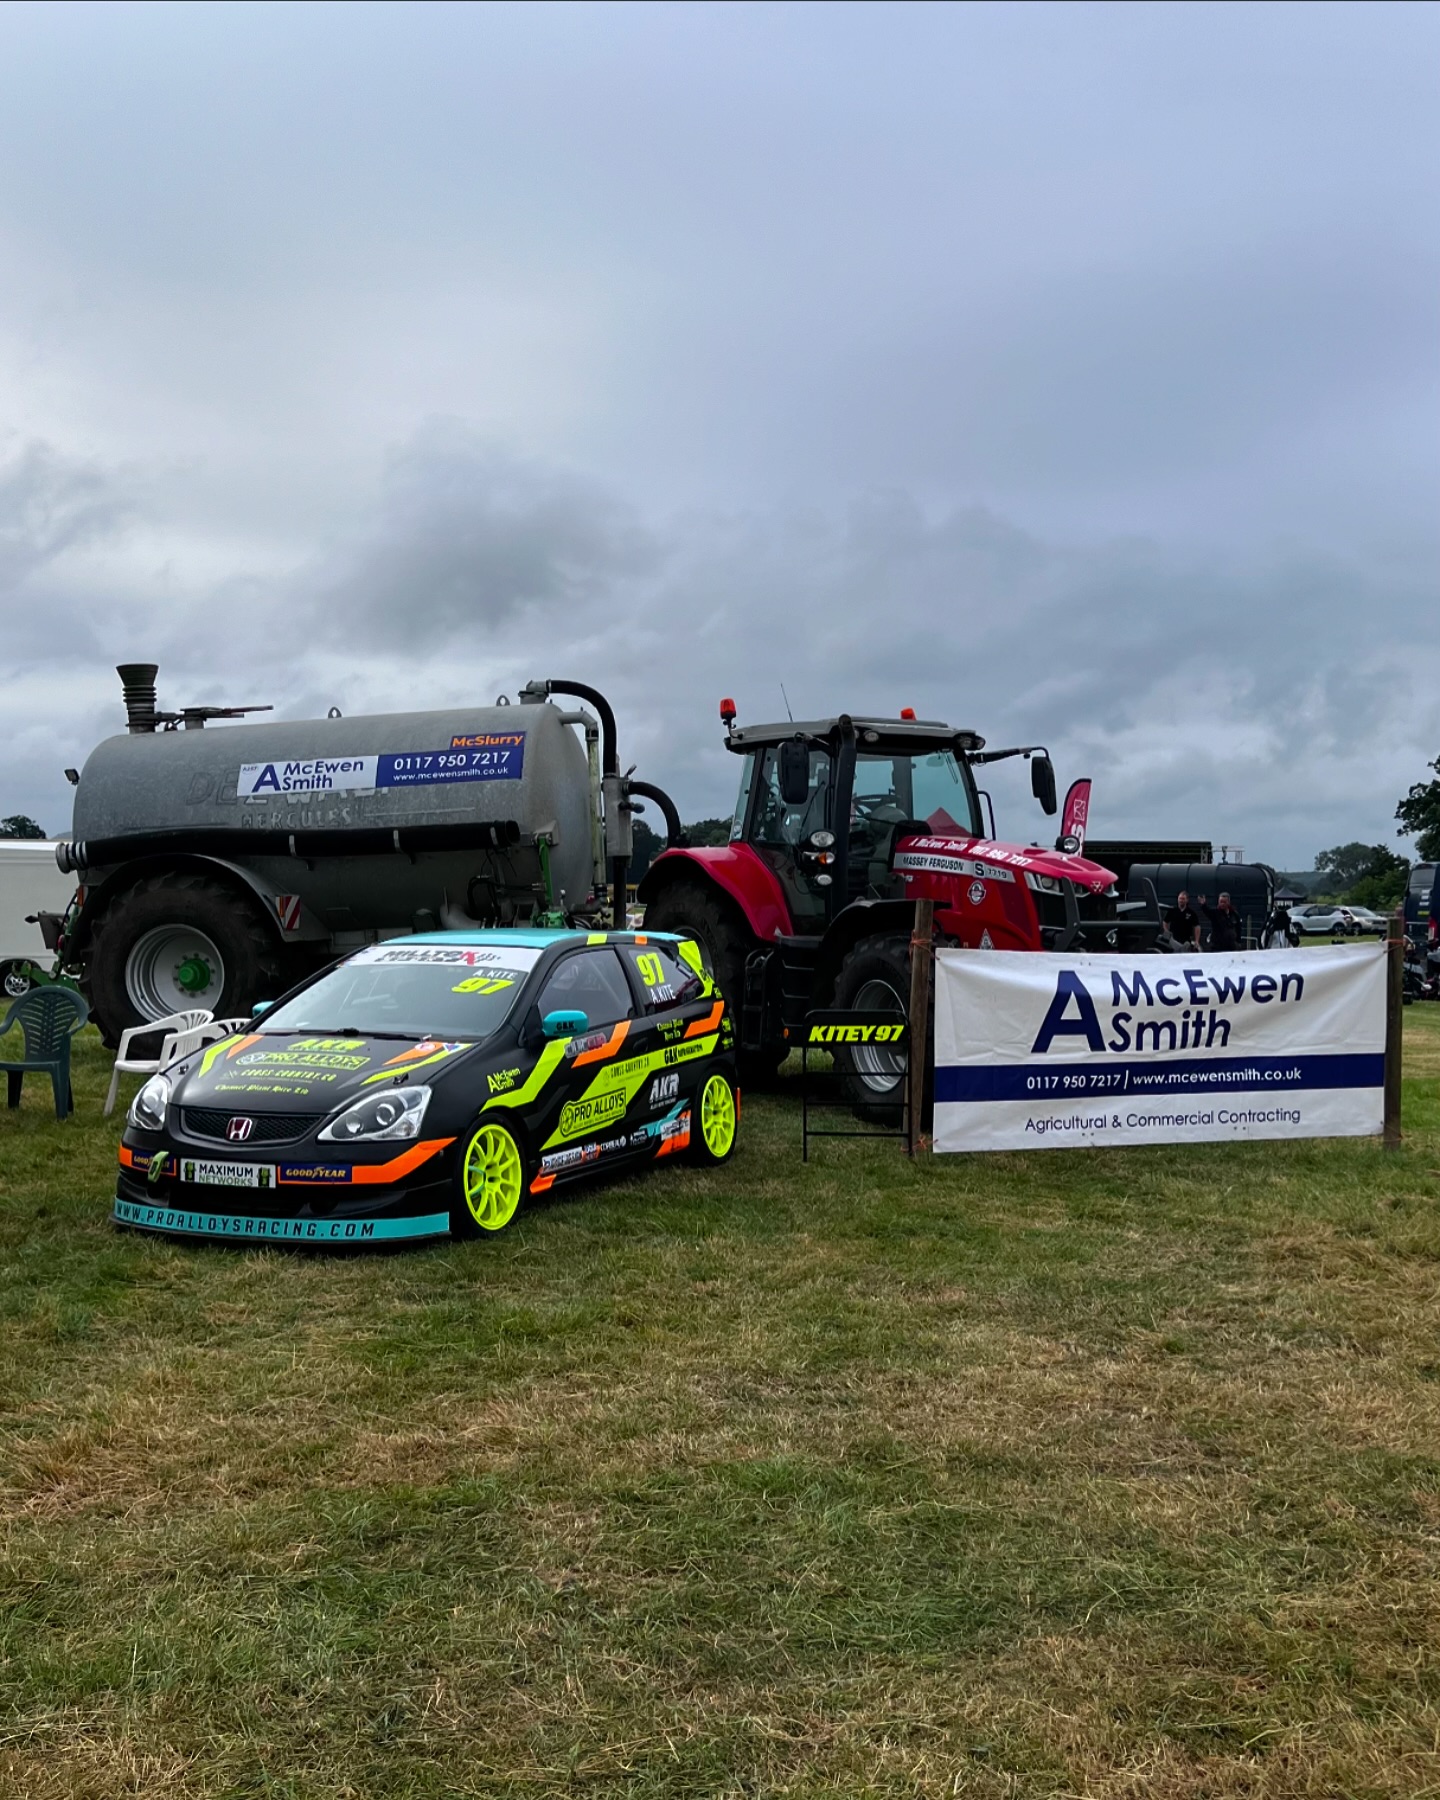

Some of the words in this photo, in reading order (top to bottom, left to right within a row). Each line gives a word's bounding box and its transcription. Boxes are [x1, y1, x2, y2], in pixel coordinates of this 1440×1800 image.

[452, 734, 524, 748] McSlurry
[394, 756, 431, 771] 0117
[437, 754, 466, 768] 950
[471, 751, 510, 766] 7217
[251, 764, 281, 793] A
[283, 760, 364, 776] McEwen
[281, 774, 332, 791] Smith
[393, 766, 509, 782] www.mcewensmith.co.uk
[241, 807, 352, 829] HERCULES
[902, 856, 928, 867] MASSEY
[928, 857, 964, 872] FERGUSON
[974, 863, 985, 877] S
[473, 969, 518, 980] A.KITE
[636, 952, 665, 987] 97
[451, 977, 515, 996] 97
[650, 984, 676, 1004] A.KITE
[1031, 970, 1107, 1053] A
[1111, 969, 1304, 1007] McEwen
[1108, 1009, 1231, 1053] Smith
[263, 1052, 299, 1063] PRO
[301, 1054, 363, 1067] ALLOYS
[650, 1073, 679, 1102] AKR
[1026, 1076, 1058, 1090] 0117
[1063, 1075, 1086, 1088] 950
[1089, 1074, 1121, 1088] 7217
[1132, 1067, 1301, 1085] www.mcewensmith.co.uk
[574, 1103, 592, 1122] PRO
[594, 1092, 624, 1115] ALLOYS
[1025, 1115, 1107, 1133] Agricultural
[1112, 1115, 1122, 1128] &
[1126, 1110, 1214, 1128] Commercial
[1218, 1107, 1300, 1125] Contracting
[199, 1163, 254, 1178] MAXIMUM
[286, 1166, 346, 1179] GOODYEAR
[199, 1175, 254, 1187] NETWORKS
[116, 1203, 375, 1237] WWW.PROALLOYSRACING.COM
